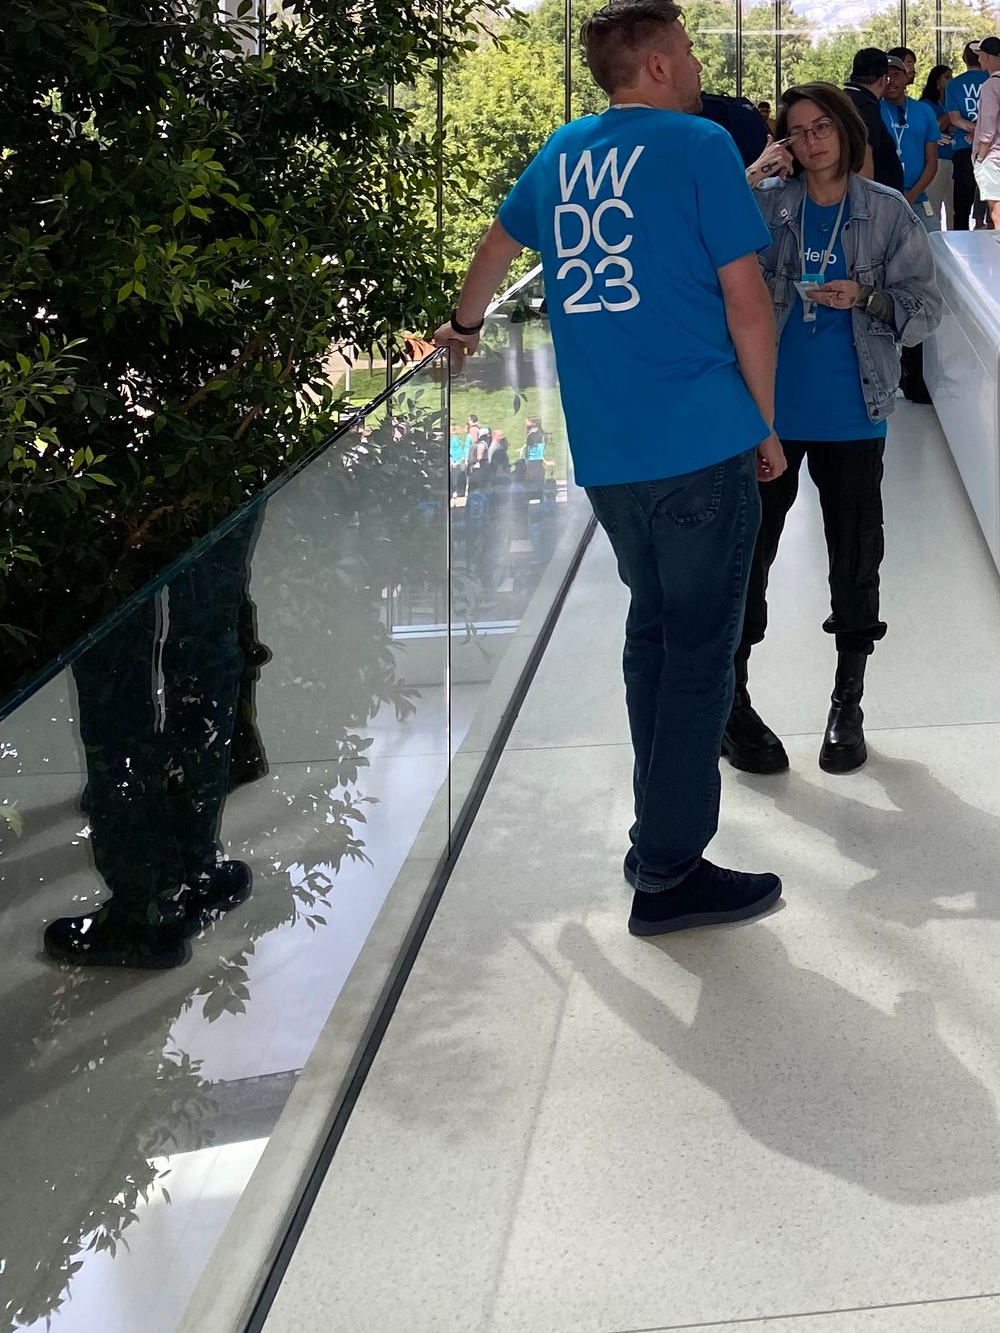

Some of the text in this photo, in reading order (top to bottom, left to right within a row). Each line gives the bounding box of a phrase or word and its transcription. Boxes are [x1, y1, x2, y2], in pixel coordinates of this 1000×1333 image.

[963, 83, 982, 97] W
[965, 97, 980, 112] D
[968, 112, 978, 122] 2
[554, 198, 634, 258] DC
[556, 255, 640, 314] 23
